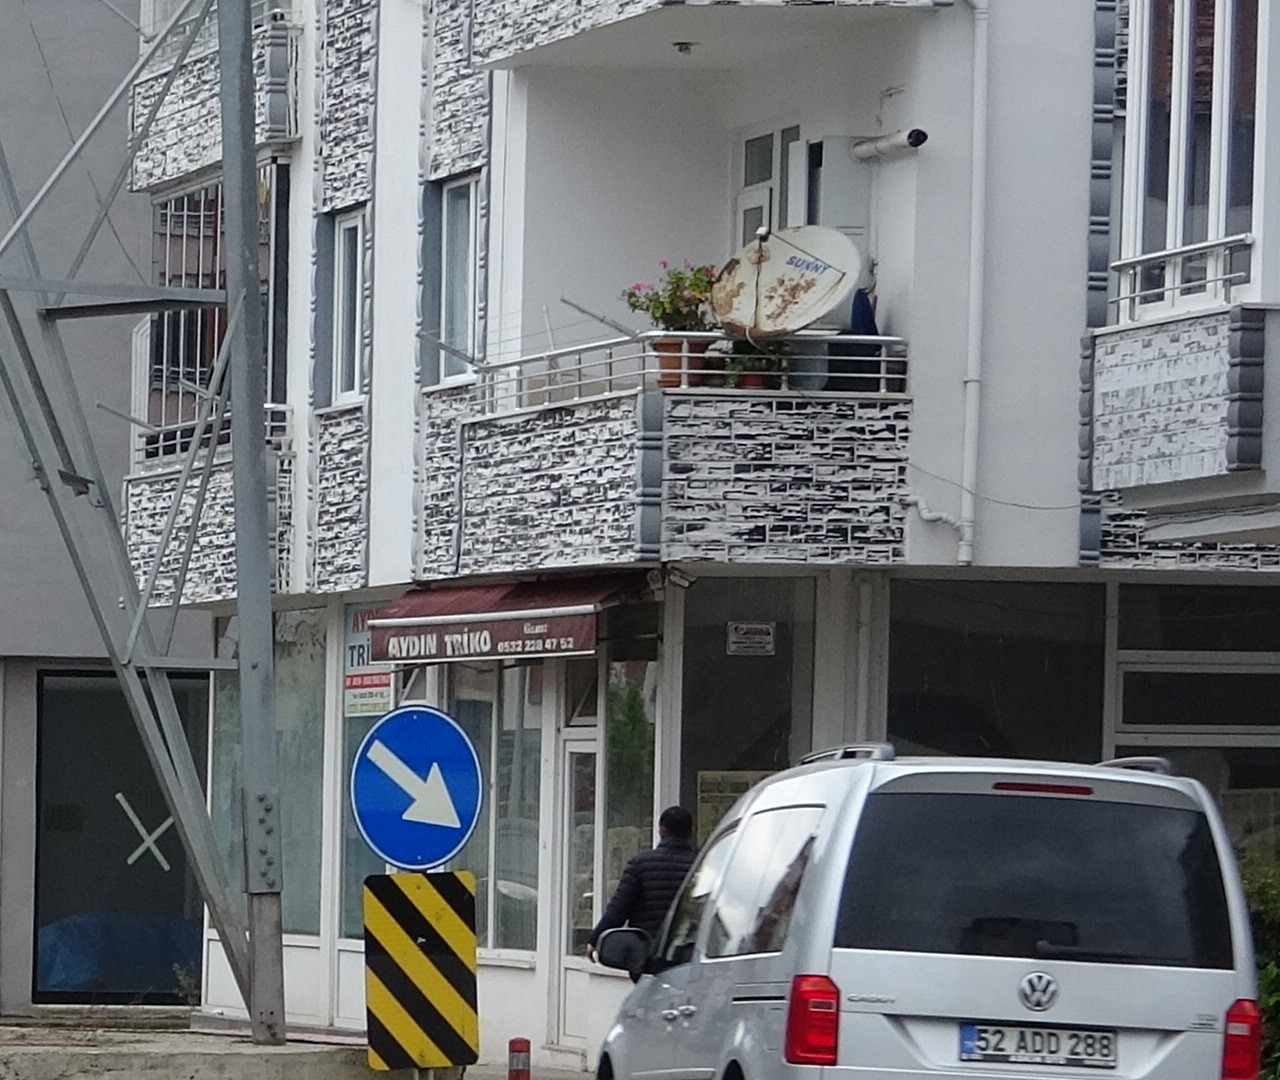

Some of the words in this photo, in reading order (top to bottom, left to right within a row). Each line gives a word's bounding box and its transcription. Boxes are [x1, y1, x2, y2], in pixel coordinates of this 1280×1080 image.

[785, 255, 831, 275] SUNNY
[348, 638, 370, 667] TRİ
[388, 633, 437, 658] AYDIN
[444, 627, 491, 656] TRİKO
[497, 640, 523, 653] 0532
[544, 638, 558, 650] 47
[976, 1028, 1006, 1053] 52
[1015, 1030, 1061, 1055] ADD
[1067, 1033, 1112, 1058] 288
